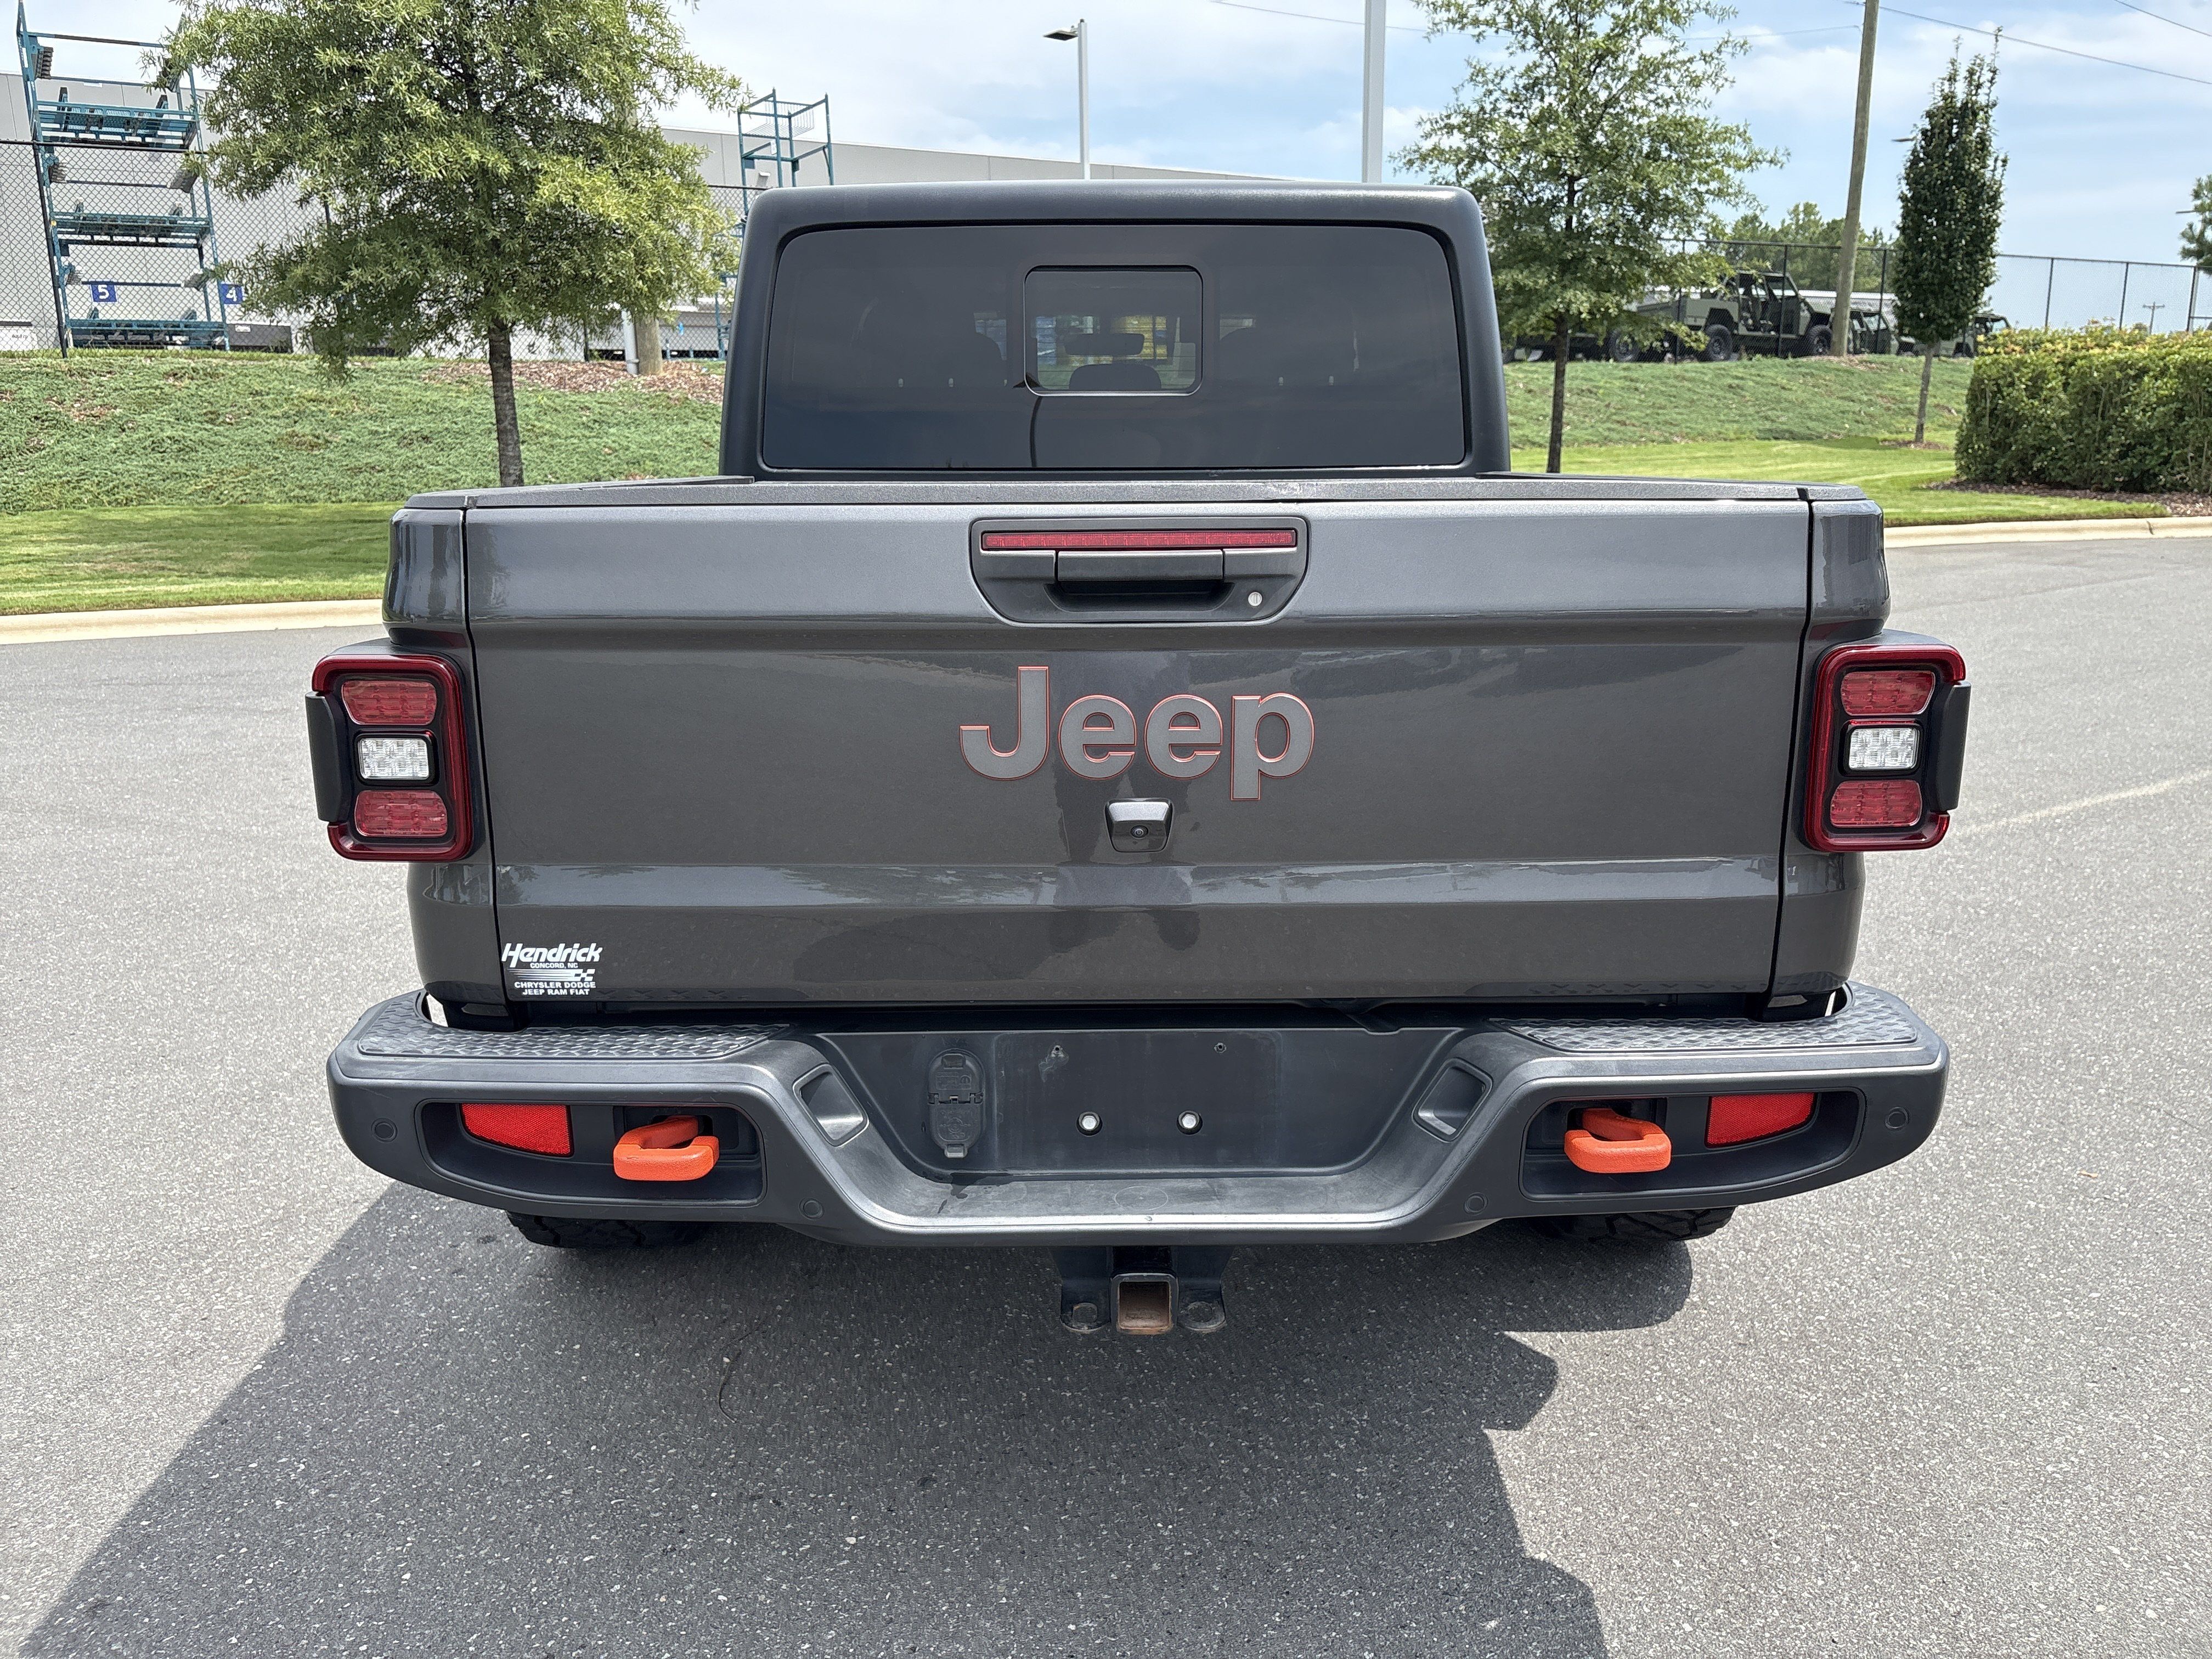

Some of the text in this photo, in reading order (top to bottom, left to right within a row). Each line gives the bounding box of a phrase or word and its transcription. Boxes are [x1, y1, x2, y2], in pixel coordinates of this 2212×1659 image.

[98, 284, 109, 299] 5
[226, 286, 238, 302] 4
[960, 665, 1315, 800] Jeep
[501, 943, 603, 968] Hendrick
